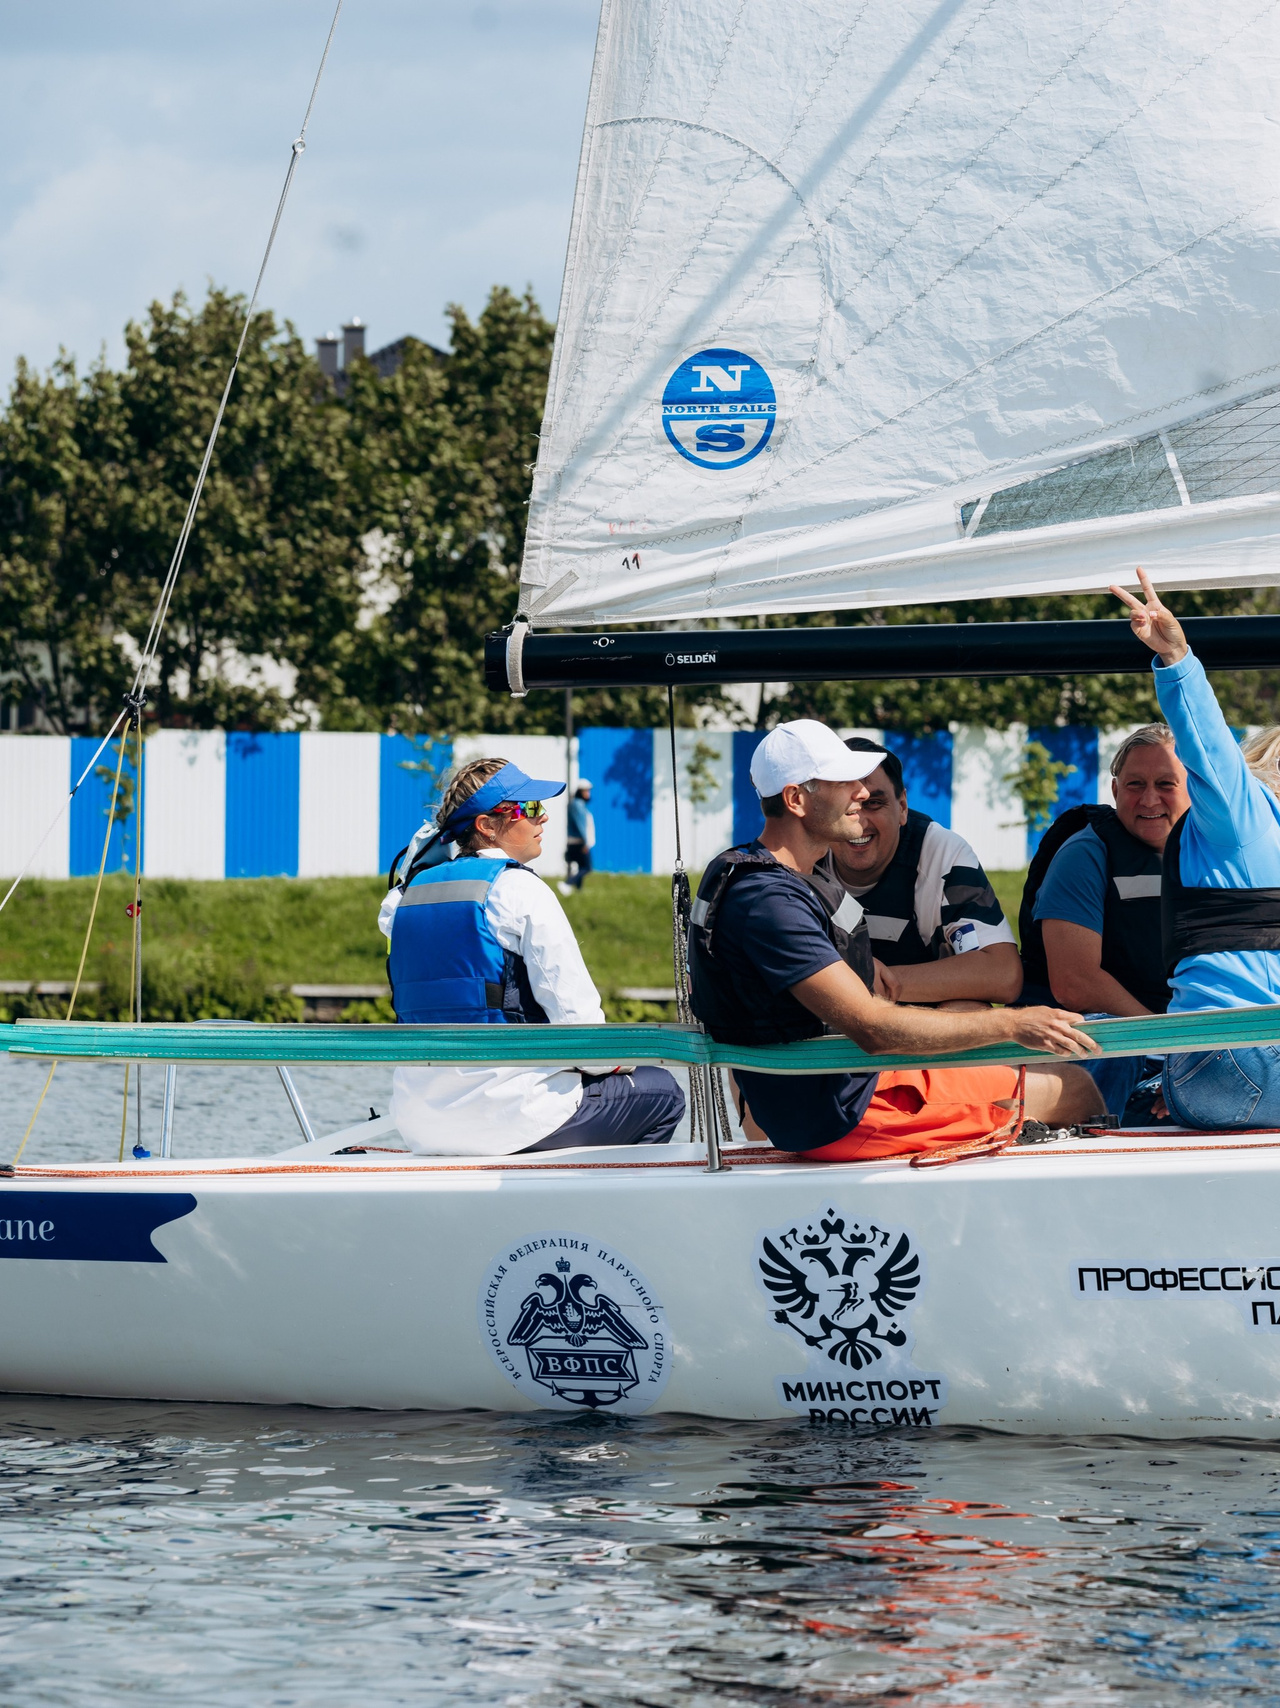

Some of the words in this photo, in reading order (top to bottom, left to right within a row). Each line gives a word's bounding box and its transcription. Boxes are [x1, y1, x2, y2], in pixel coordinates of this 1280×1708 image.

[691, 365, 751, 392] N
[662, 405, 721, 414] NORTH
[728, 404, 777, 413] SAILS
[695, 423, 746, 453] S
[621, 553, 641, 570] 11
[676, 652, 717, 664] SELDÉN
[484, 1265, 522, 1381] ВСЕРОССИЙСКАЯ
[508, 1237, 589, 1263] ФЕДЕРАЦИЯ
[597, 1249, 660, 1324] ПАРУСНОГО
[647, 1332, 665, 1383] СПОРТА
[546, 1356, 620, 1375] ВФПС
[781, 1379, 942, 1402] МИНСПОРТ
